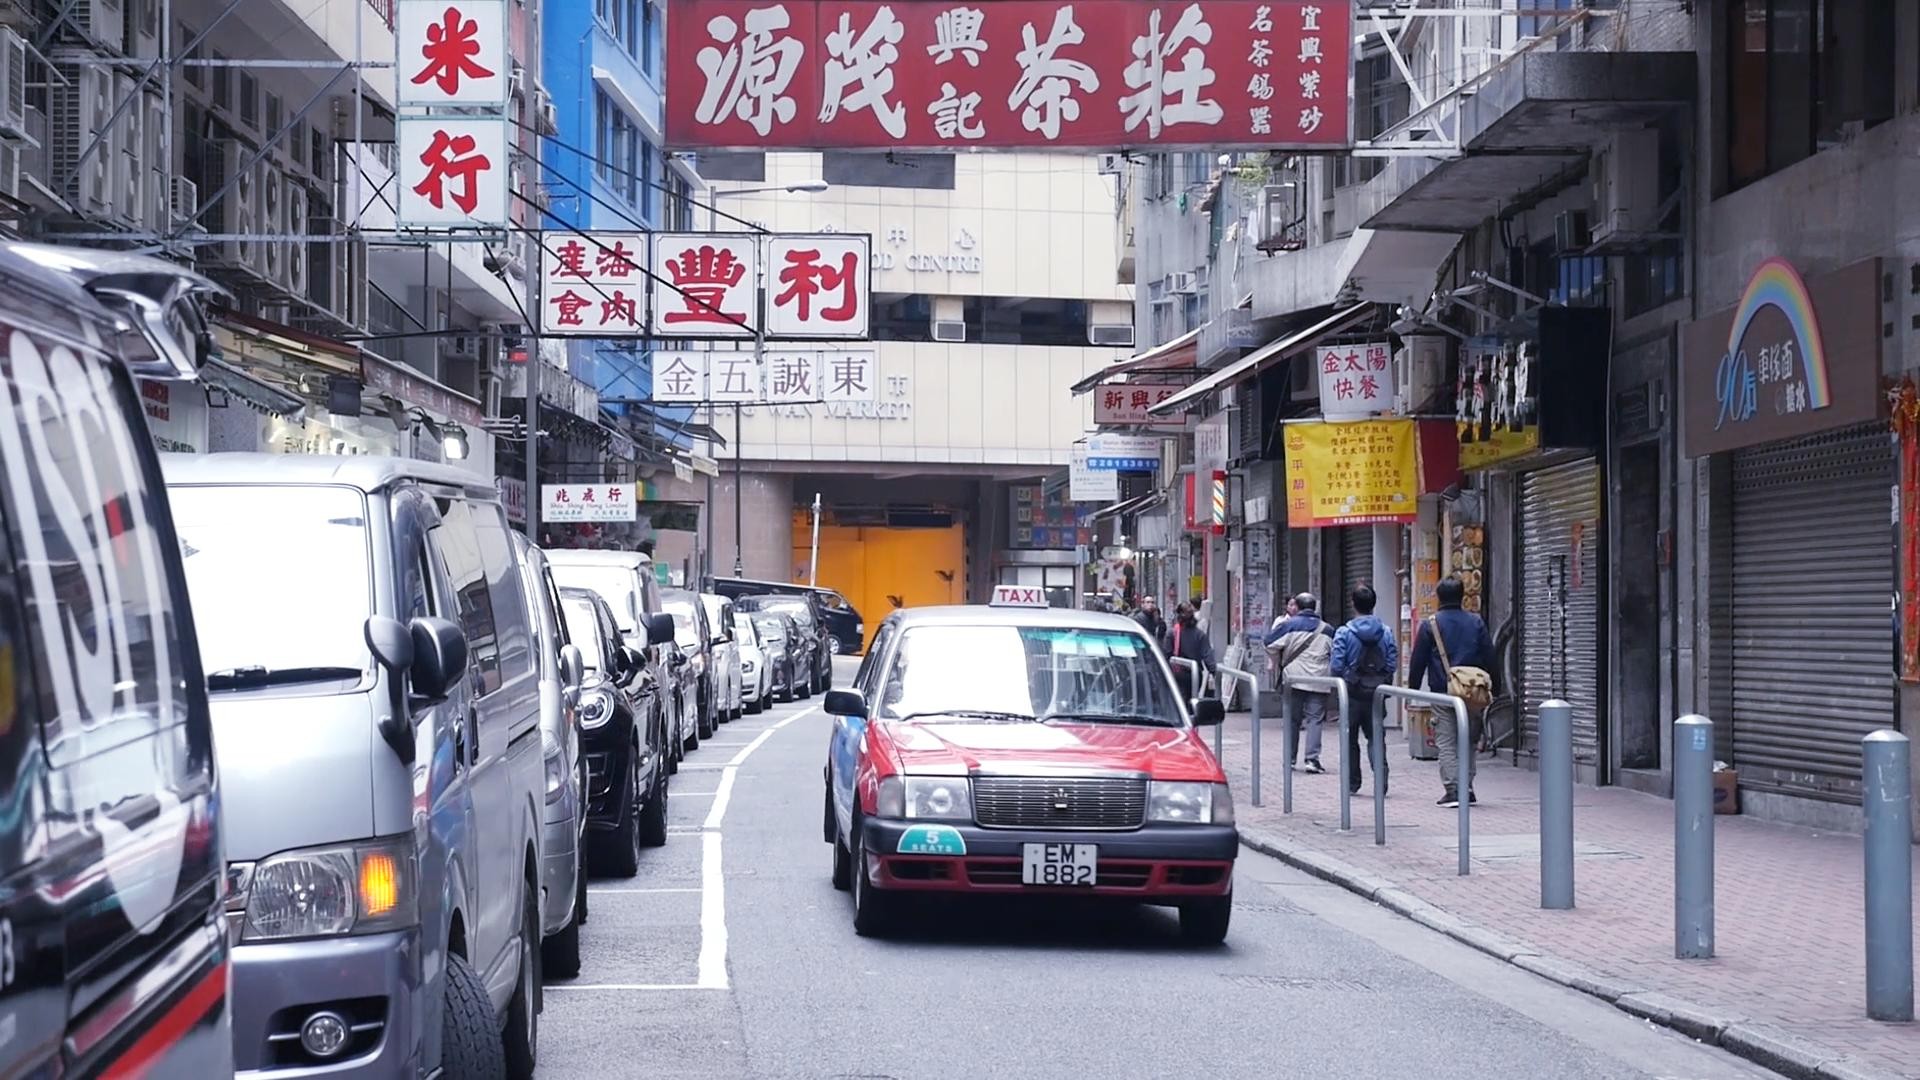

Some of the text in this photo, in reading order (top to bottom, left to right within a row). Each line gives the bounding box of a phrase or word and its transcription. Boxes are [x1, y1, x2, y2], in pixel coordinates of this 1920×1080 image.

[904, 252, 982, 274] CENTRE
[1322, 348, 1388, 374] 金太陽
[1333, 375, 1379, 400] 快餐
[998, 589, 1043, 604] TAXI
[926, 830, 940, 844] 5
[911, 844, 952, 853] SEATS
[1045, 844, 1075, 863] EM
[1031, 864, 1092, 885] 1882
